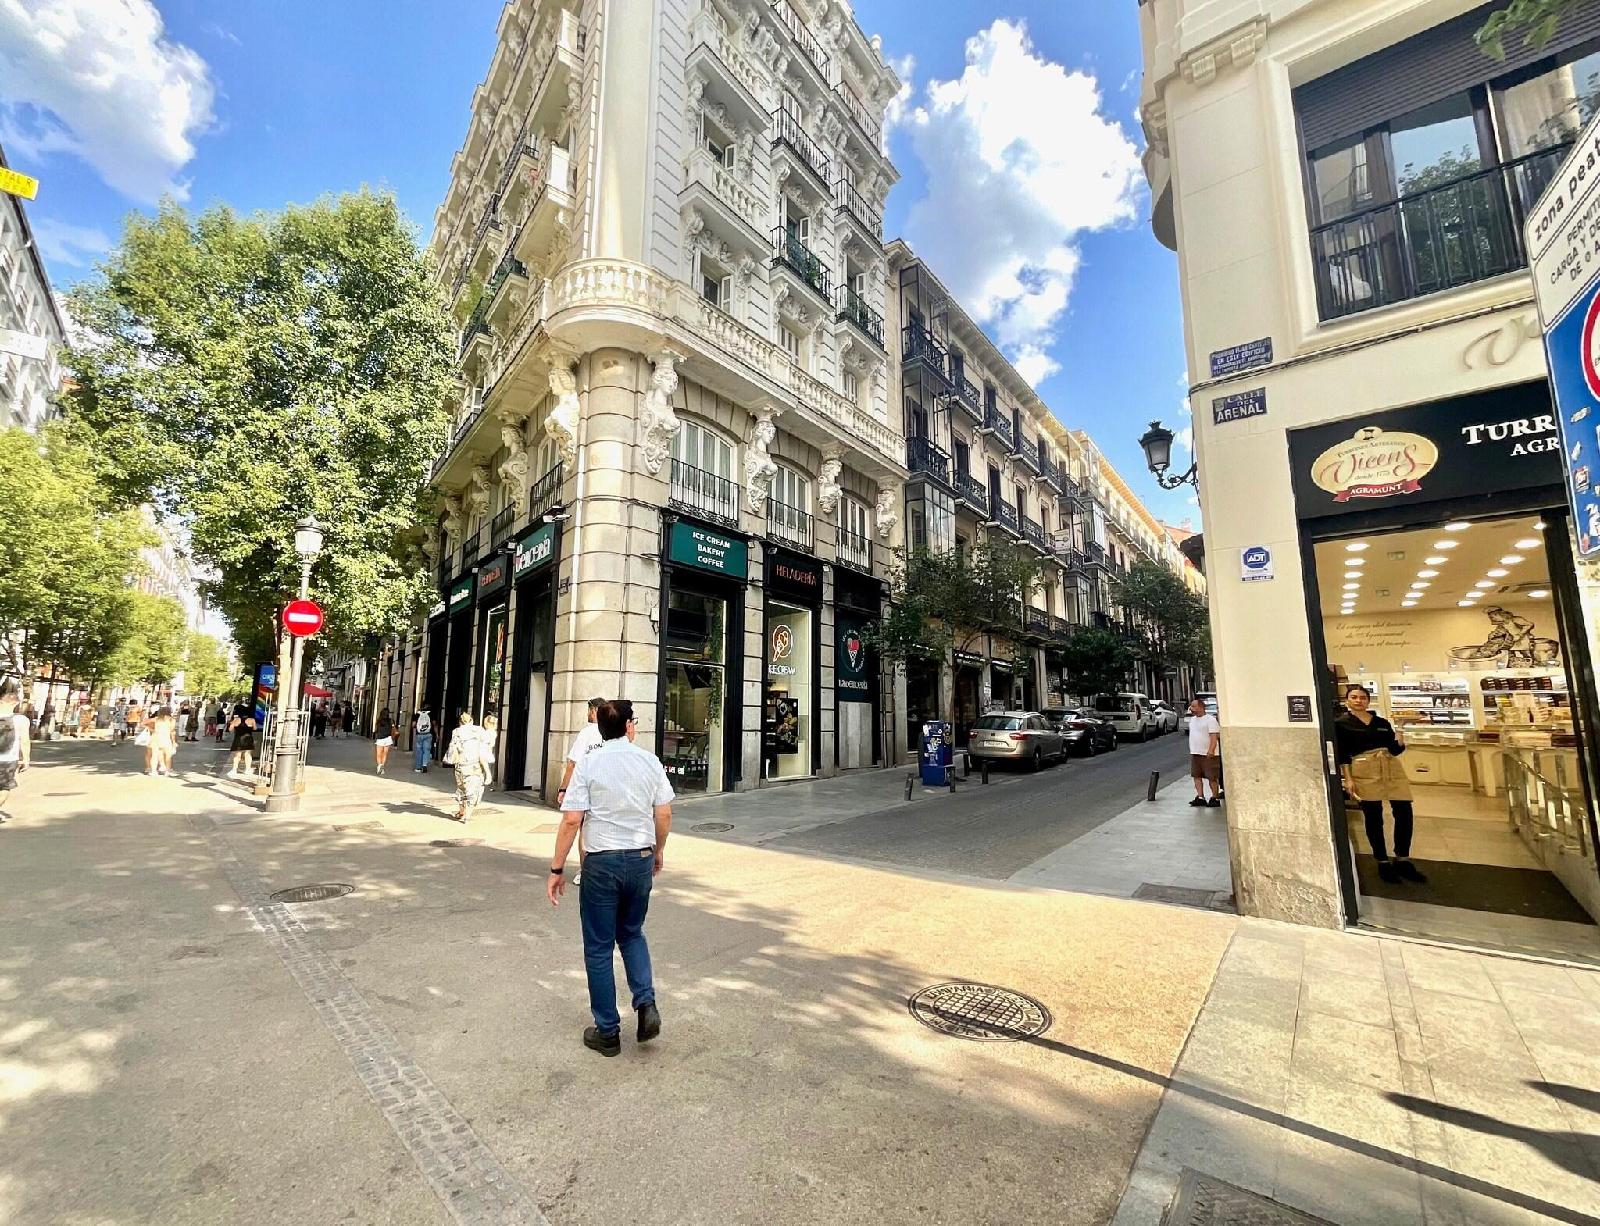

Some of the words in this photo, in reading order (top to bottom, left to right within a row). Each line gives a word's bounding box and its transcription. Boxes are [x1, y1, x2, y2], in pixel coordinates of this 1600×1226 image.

[1535, 195, 1564, 242] zona
[1551, 246, 1579, 285] CARGA
[1580, 233, 1586, 249] Y
[1570, 260, 1583, 282] DE
[1227, 389, 1263, 403] CALLE
[1237, 398, 1256, 407] DEL
[1216, 402, 1264, 422] ARENAL
[1461, 414, 1558, 445] TURR
[1510, 436, 1560, 457] AGR
[1350, 483, 1403, 496] AGRAMUNT
[692, 531, 705, 541] ICE
[706, 535, 731, 549] CREAM
[697, 543, 725, 559] BAKERY
[1247, 553, 1266, 563] ADT
[697, 555, 724, 569] COFFEE
[776, 563, 817, 587] HELADERÍA
